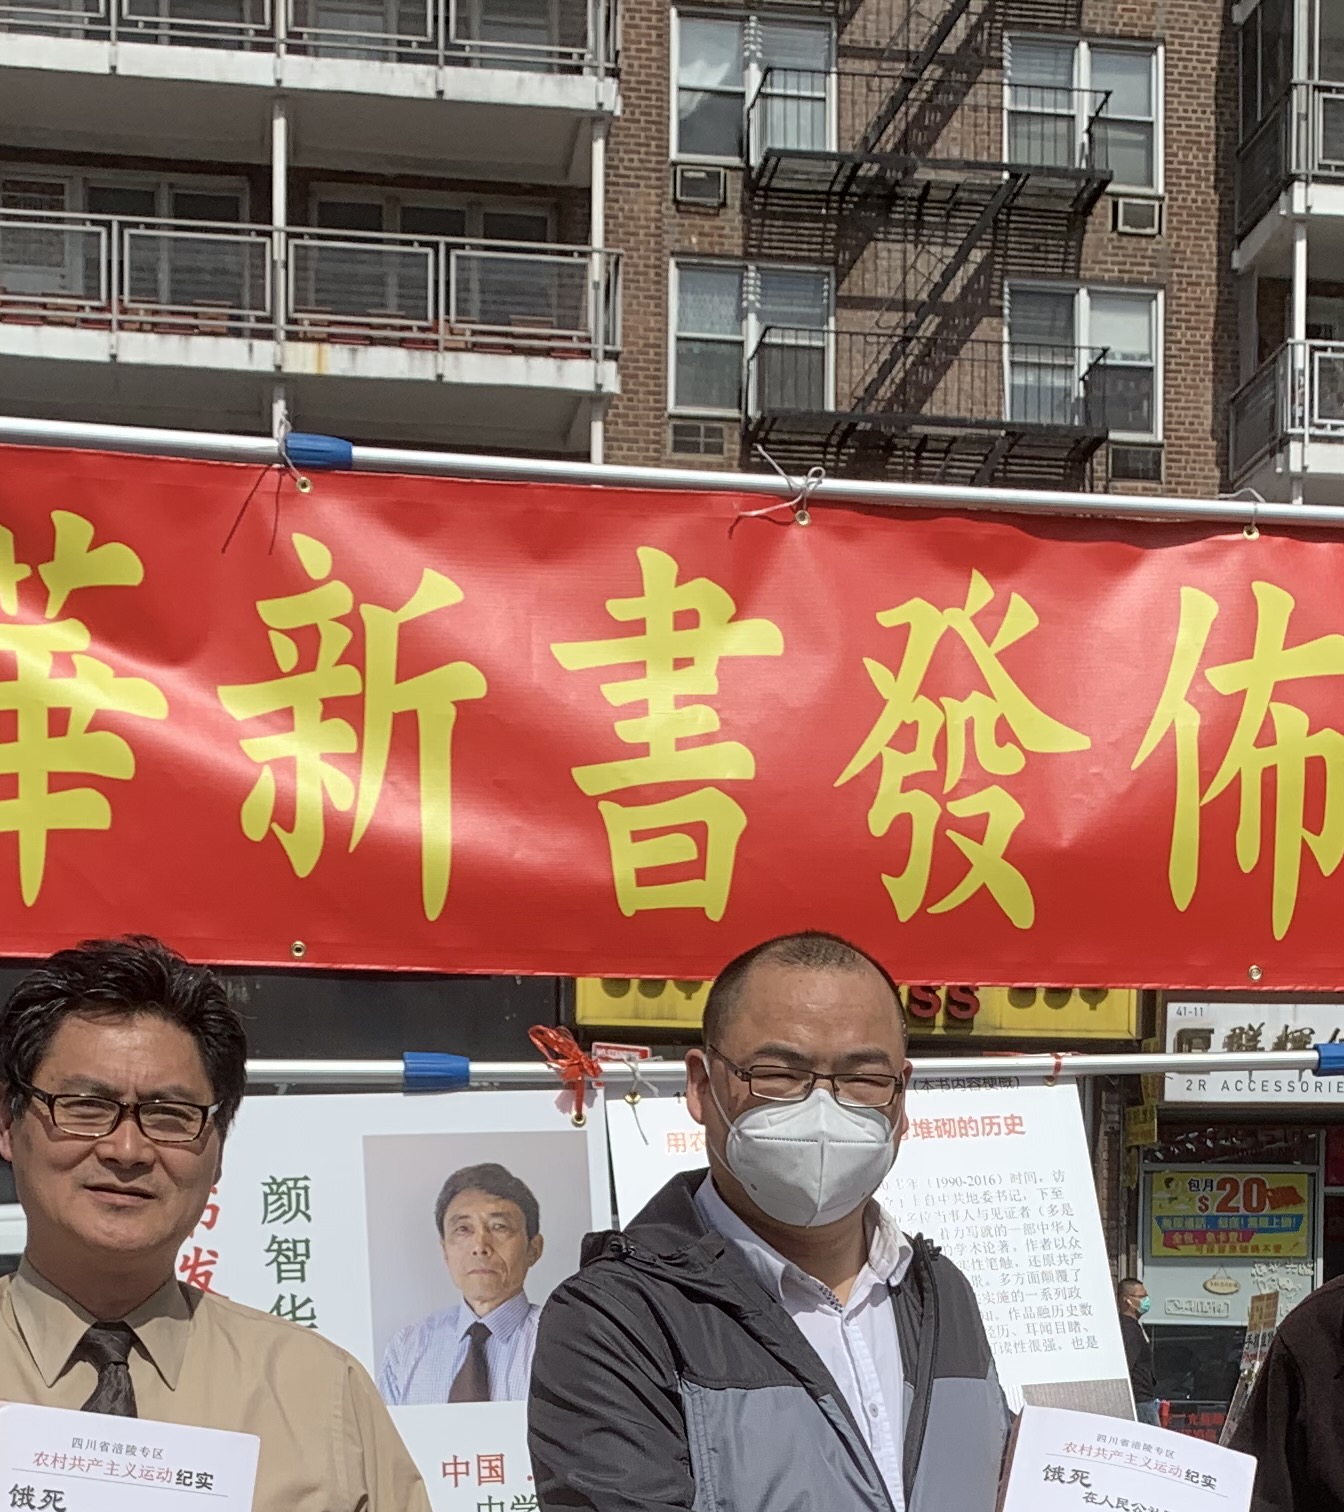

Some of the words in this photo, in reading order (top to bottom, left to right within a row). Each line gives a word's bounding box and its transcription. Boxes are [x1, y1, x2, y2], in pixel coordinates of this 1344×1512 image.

[1176, 1006, 1204, 1017] 41-11
[1186, 1080, 1207, 1091] 2R
[33, 1450, 214, 1491] 农村共产主义运动纪实
